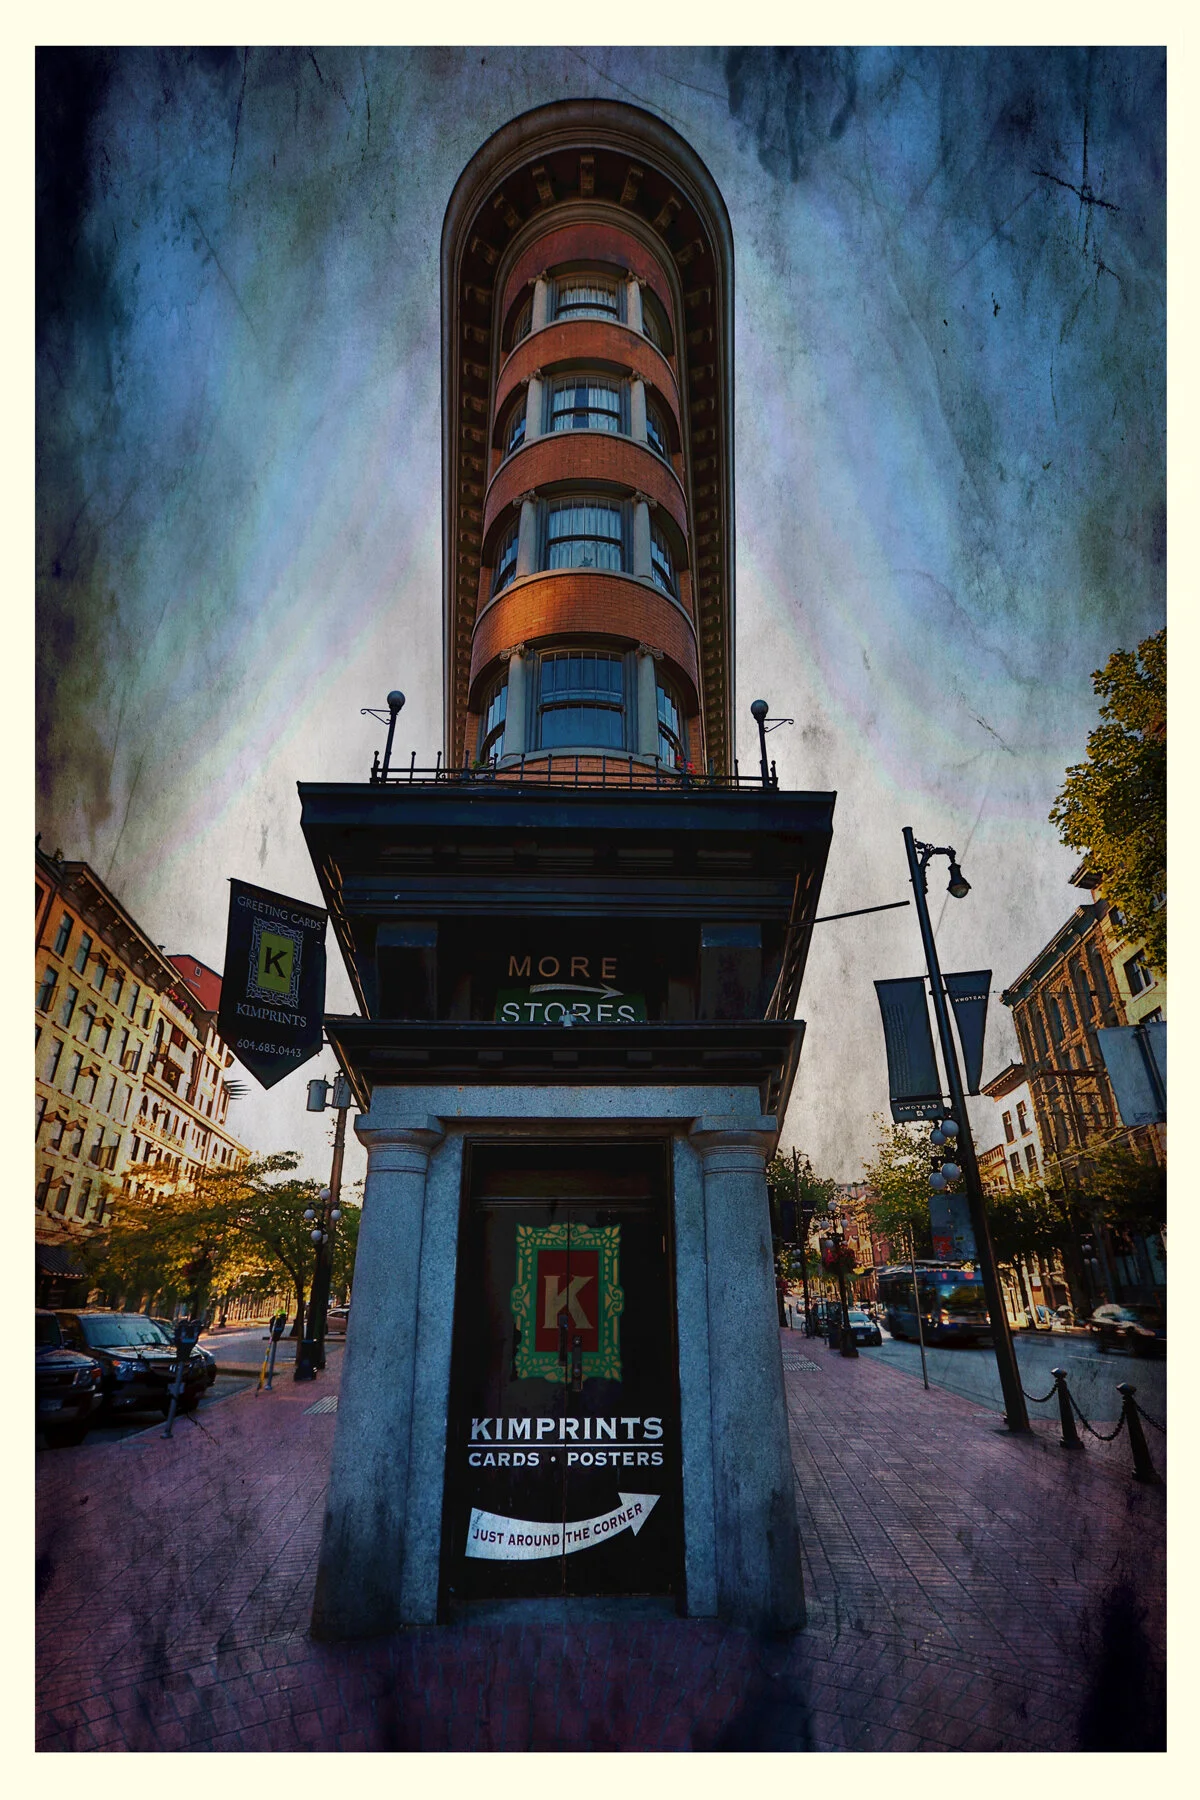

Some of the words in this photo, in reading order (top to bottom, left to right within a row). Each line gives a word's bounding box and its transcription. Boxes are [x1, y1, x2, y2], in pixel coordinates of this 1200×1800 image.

[237, 895, 288, 921] GREETING
[290, 913, 322, 932] CARDS
[263, 946, 288, 979] K
[508, 955, 618, 979] MORE
[236, 1003, 307, 1028] KIMPRINTS
[501, 1002, 636, 1022] STORES
[236, 1038, 302, 1058] 604.685.0443
[542, 1275, 594, 1329] K
[470, 1417, 664, 1440] KIMPRINTS
[468, 1452, 540, 1467] CARDS
[567, 1452, 664, 1466] POSTERS
[473, 1528, 504, 1544] JUST
[508, 1533, 560, 1546] AROUND
[565, 1527, 590, 1543] THE
[593, 1503, 643, 1535] CORNER
